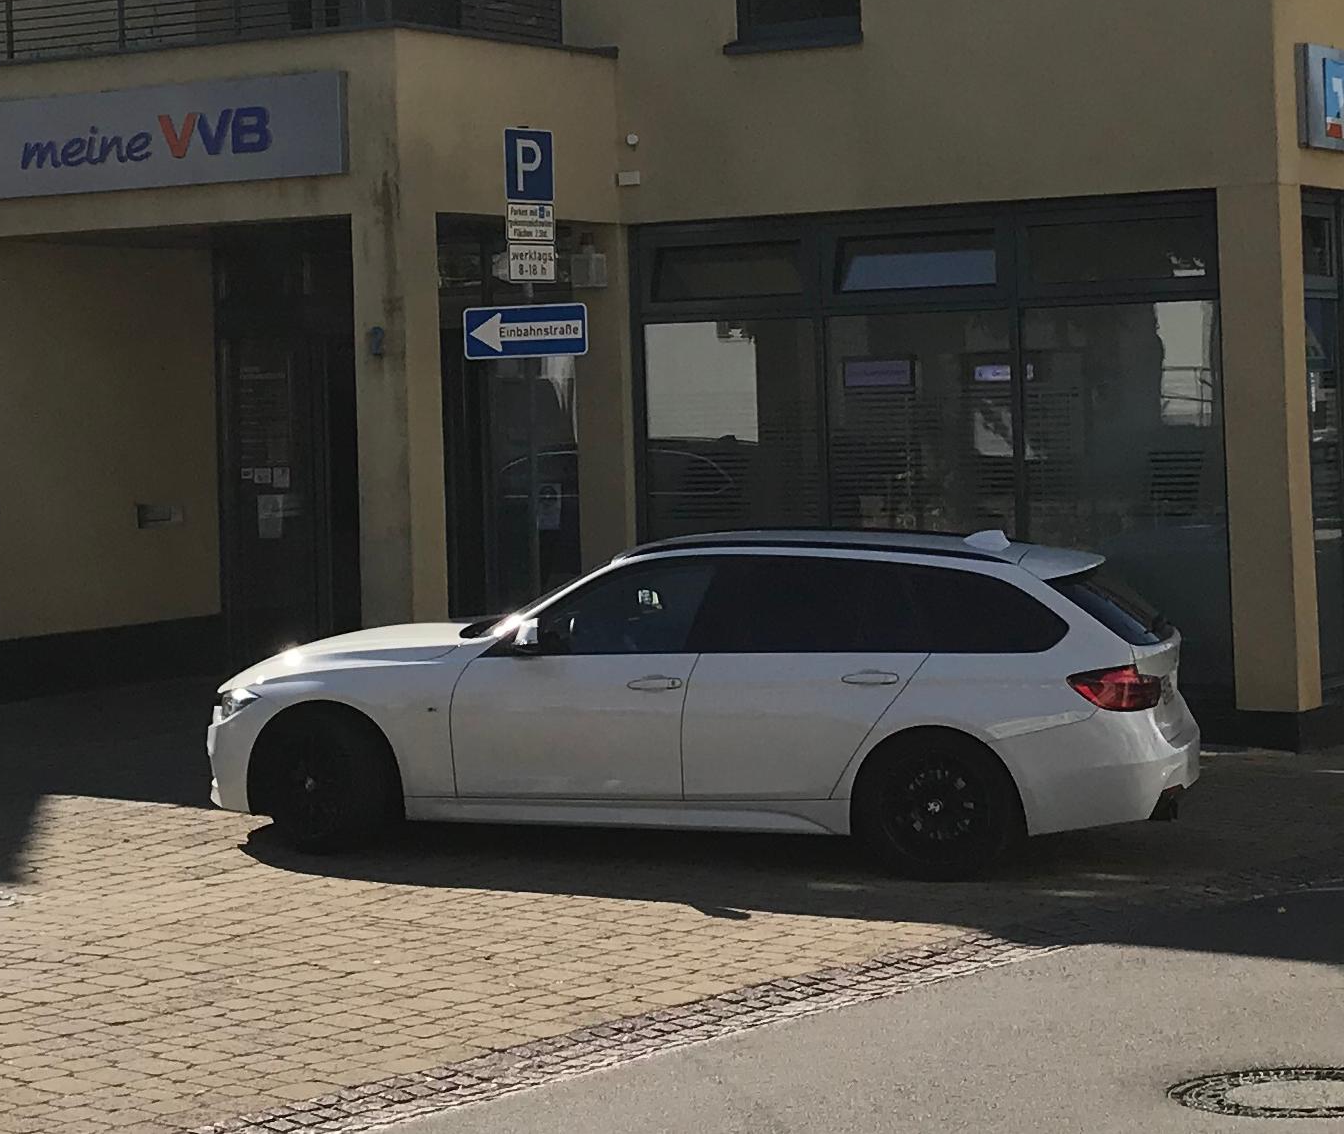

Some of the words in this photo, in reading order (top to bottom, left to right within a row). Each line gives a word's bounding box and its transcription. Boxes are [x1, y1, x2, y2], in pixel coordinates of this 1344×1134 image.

[515, 138, 542, 192] P
[511, 250, 554, 264] werktags
[499, 323, 579, 339] Einbahnstraße
